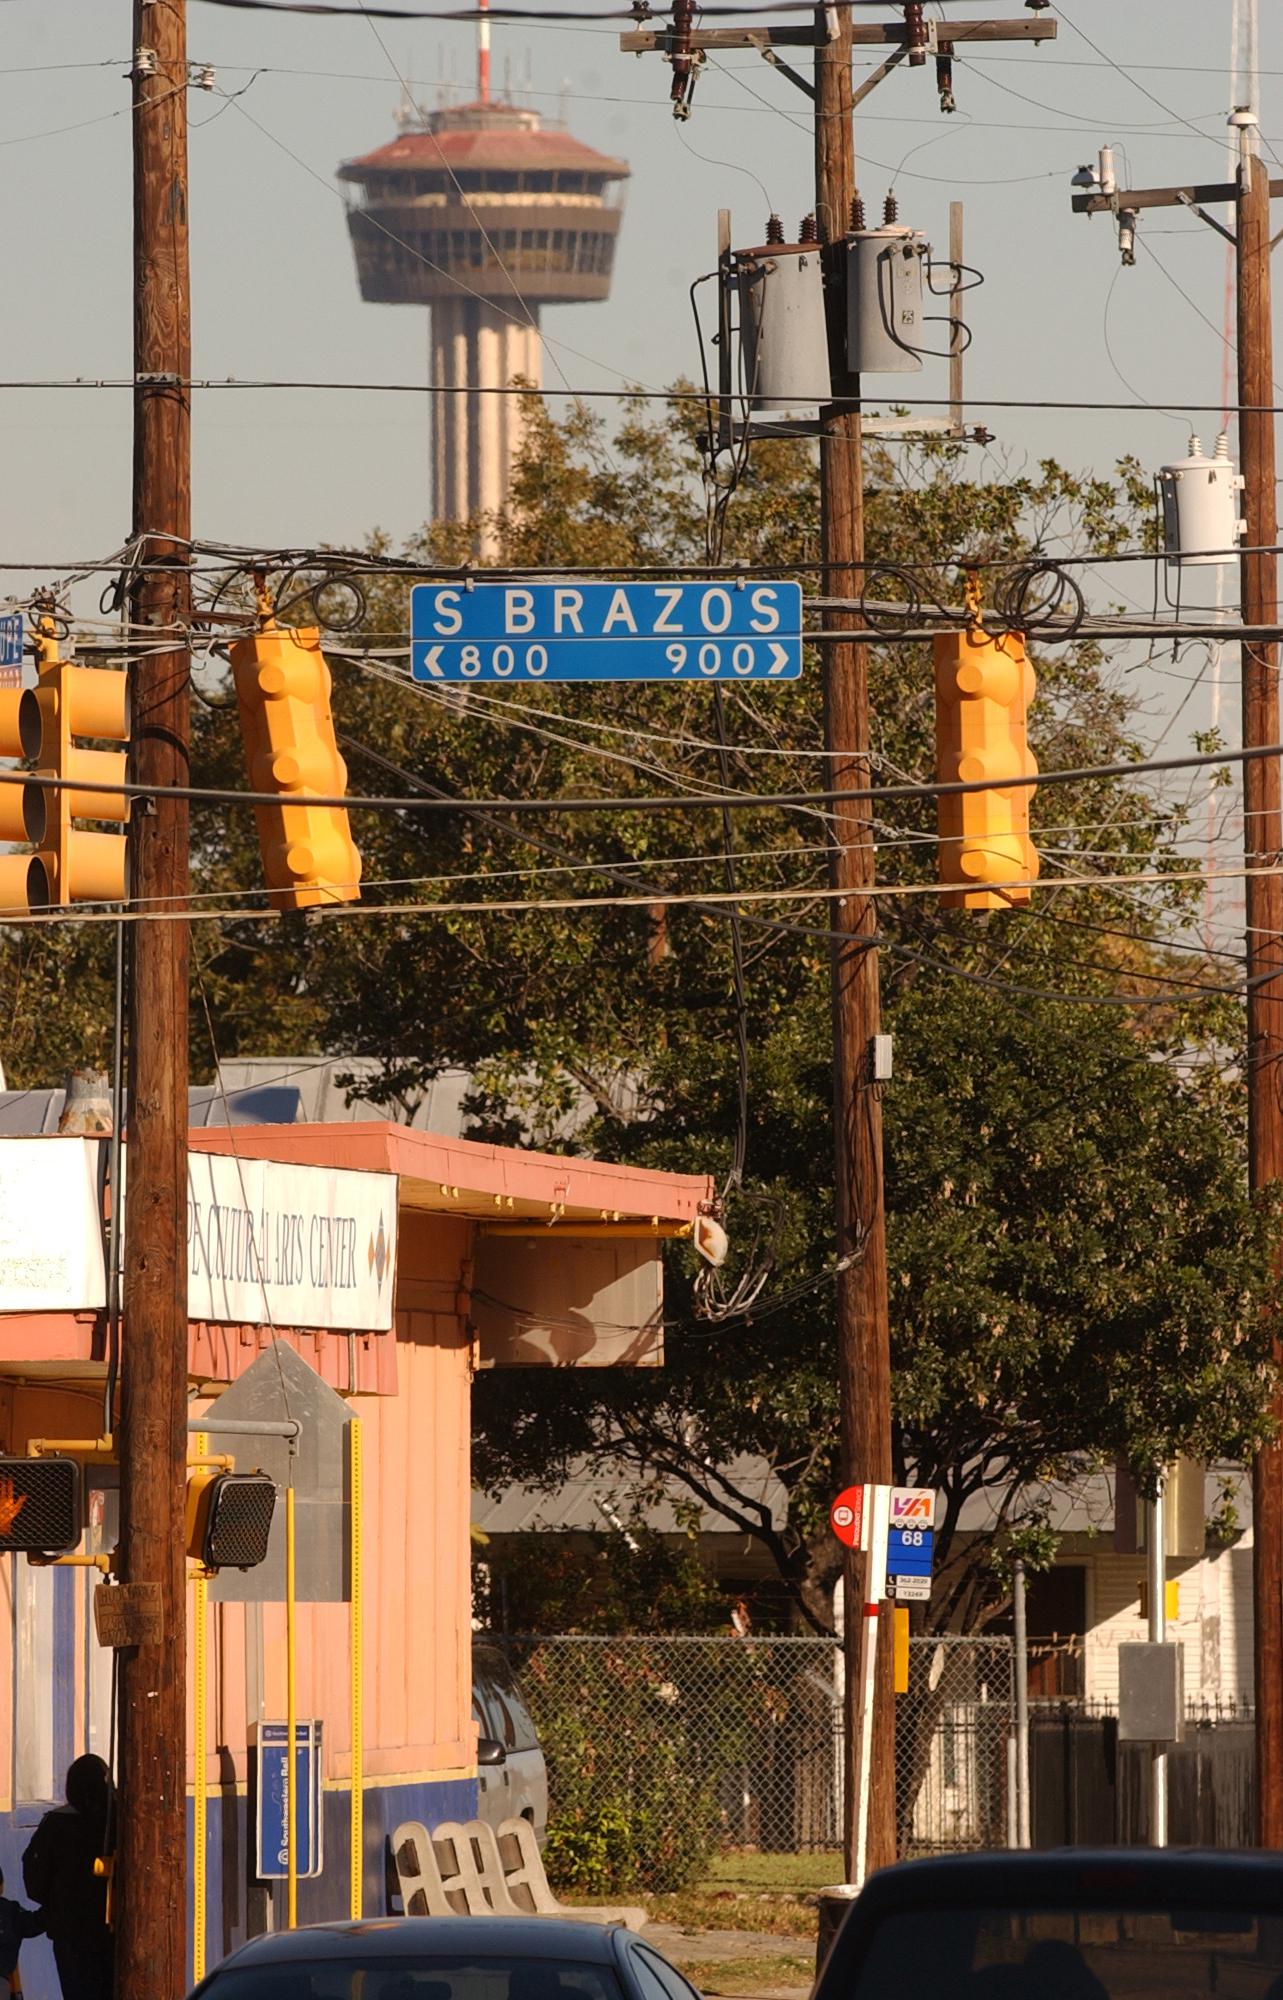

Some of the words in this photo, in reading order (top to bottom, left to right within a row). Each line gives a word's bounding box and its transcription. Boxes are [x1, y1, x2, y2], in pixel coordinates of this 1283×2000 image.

[433, 590, 463, 635] S
[504, 587, 780, 634] BRAZOS
[459, 644, 549, 677] 800
[665, 643, 755, 674] 900
[207, 1203, 271, 1284] CULTURAL
[274, 1210, 304, 1286] ARTS
[309, 1213, 357, 1289] CENTER
[902, 1530, 923, 1546] 68
